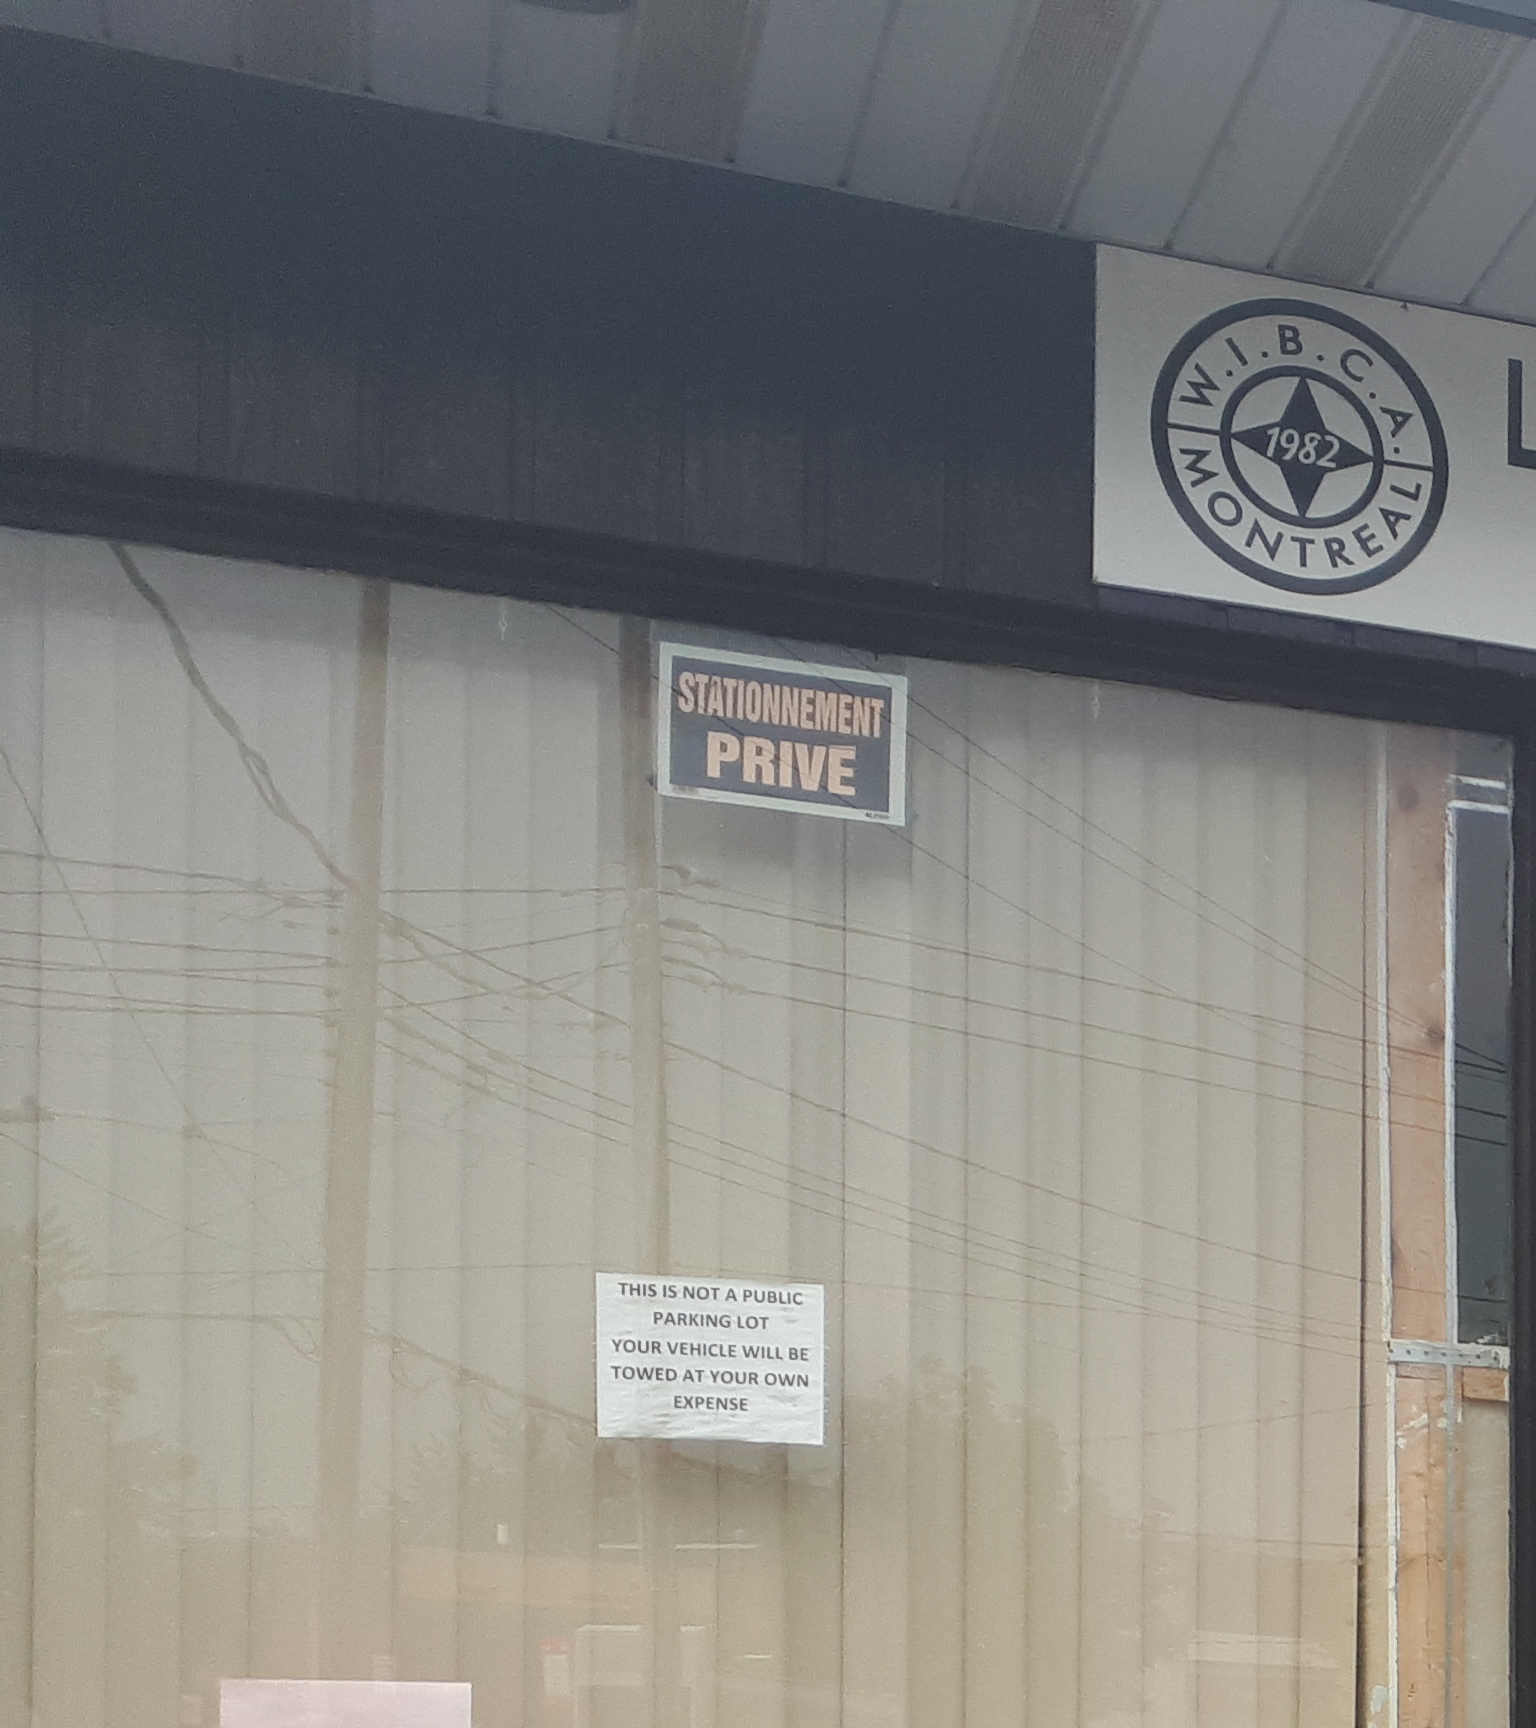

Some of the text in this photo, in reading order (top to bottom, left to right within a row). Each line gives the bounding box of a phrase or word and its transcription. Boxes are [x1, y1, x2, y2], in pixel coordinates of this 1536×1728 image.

[1265, 426, 1341, 469] 1982
[1178, 448, 1422, 569] MONTREAL
[677, 671, 885, 738] STATIONNEMENT
[706, 731, 857, 796] PRIVE
[617, 1282, 805, 1306] THIS IS NOT A PUBLIC
[653, 1311, 769, 1330] PARKING LOT
[611, 1339, 809, 1361] YOUR VEHICLE WILL BE
[610, 1366, 809, 1388] TOWED AT YOUR OWN
[674, 1396, 749, 1412] EXPENSE
